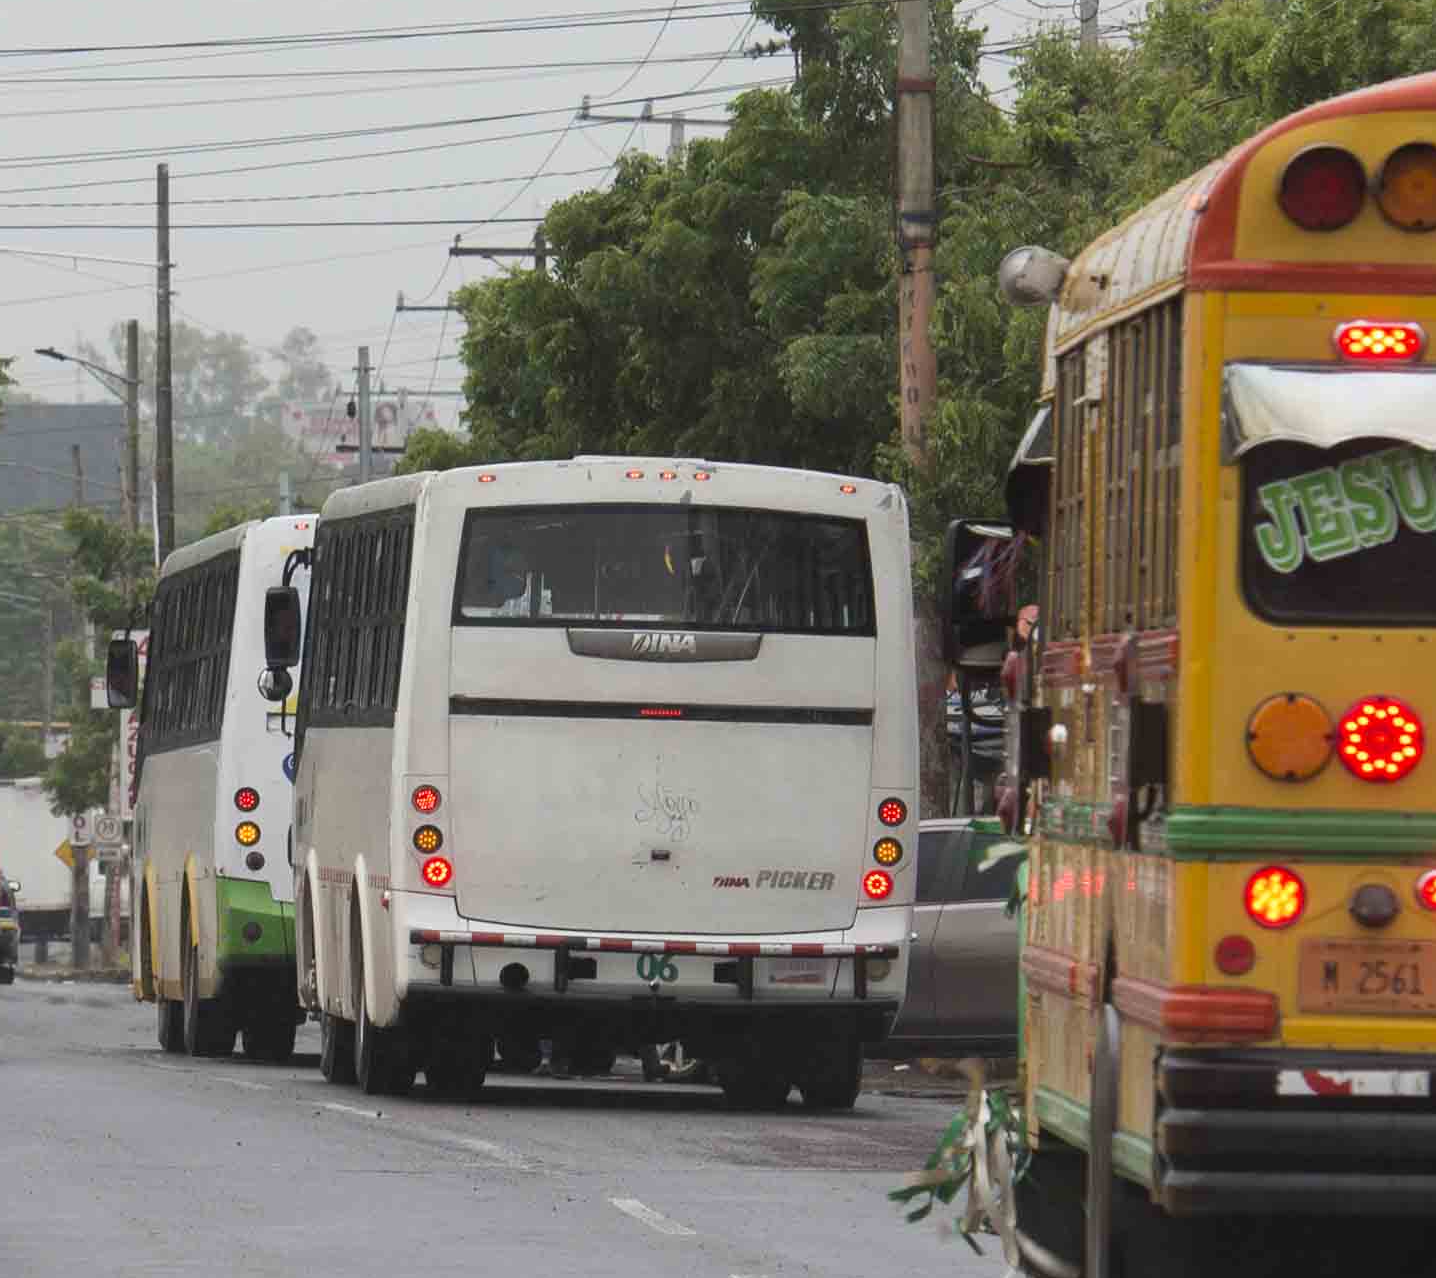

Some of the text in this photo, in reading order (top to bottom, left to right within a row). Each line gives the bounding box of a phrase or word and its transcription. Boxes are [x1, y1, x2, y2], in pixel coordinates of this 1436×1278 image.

[632, 633, 696, 654] DINA
[756, 870, 836, 890] PICKER
[637, 953, 679, 982] 06
